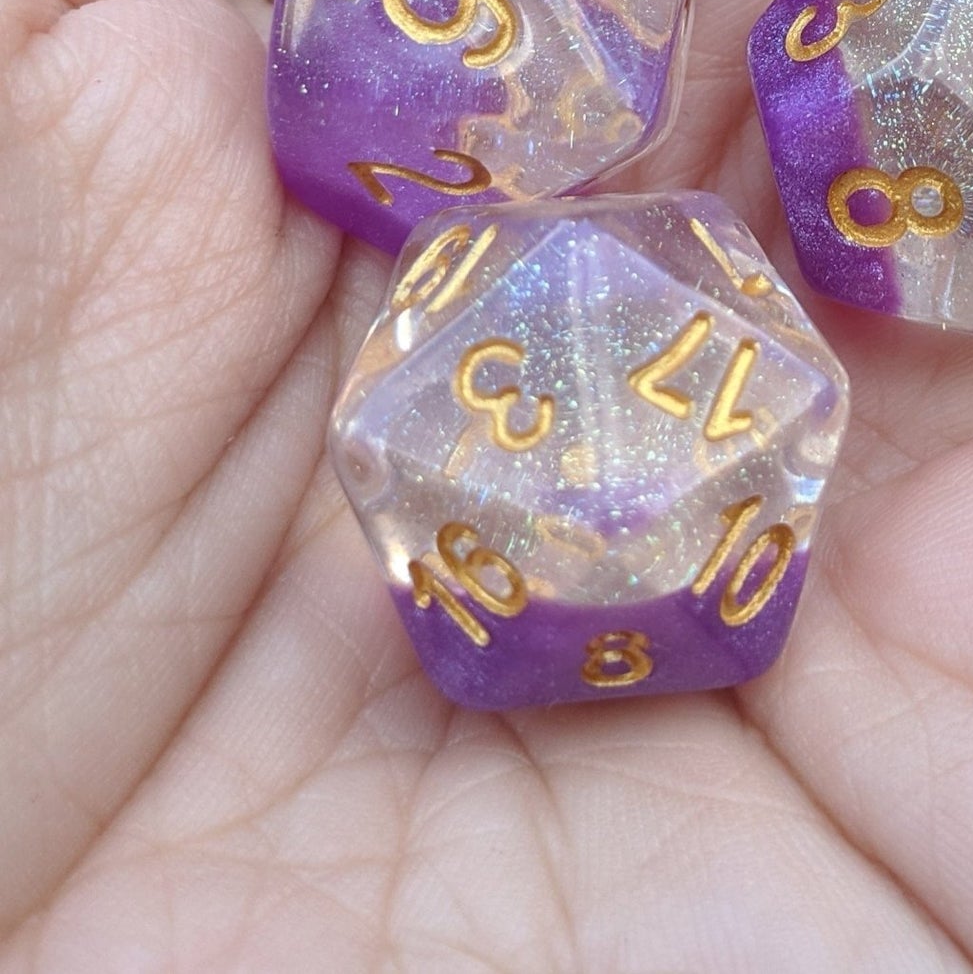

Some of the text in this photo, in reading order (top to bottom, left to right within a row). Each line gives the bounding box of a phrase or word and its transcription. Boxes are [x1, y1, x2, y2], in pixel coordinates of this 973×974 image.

[348, 149, 492, 206] 2
[827, 166, 964, 249] 8
[454, 339, 554, 452] 3
[629, 311, 760, 442] 17
[408, 522, 527, 648] 16
[692, 494, 796, 627] 10
[581, 630, 653, 687] 8
